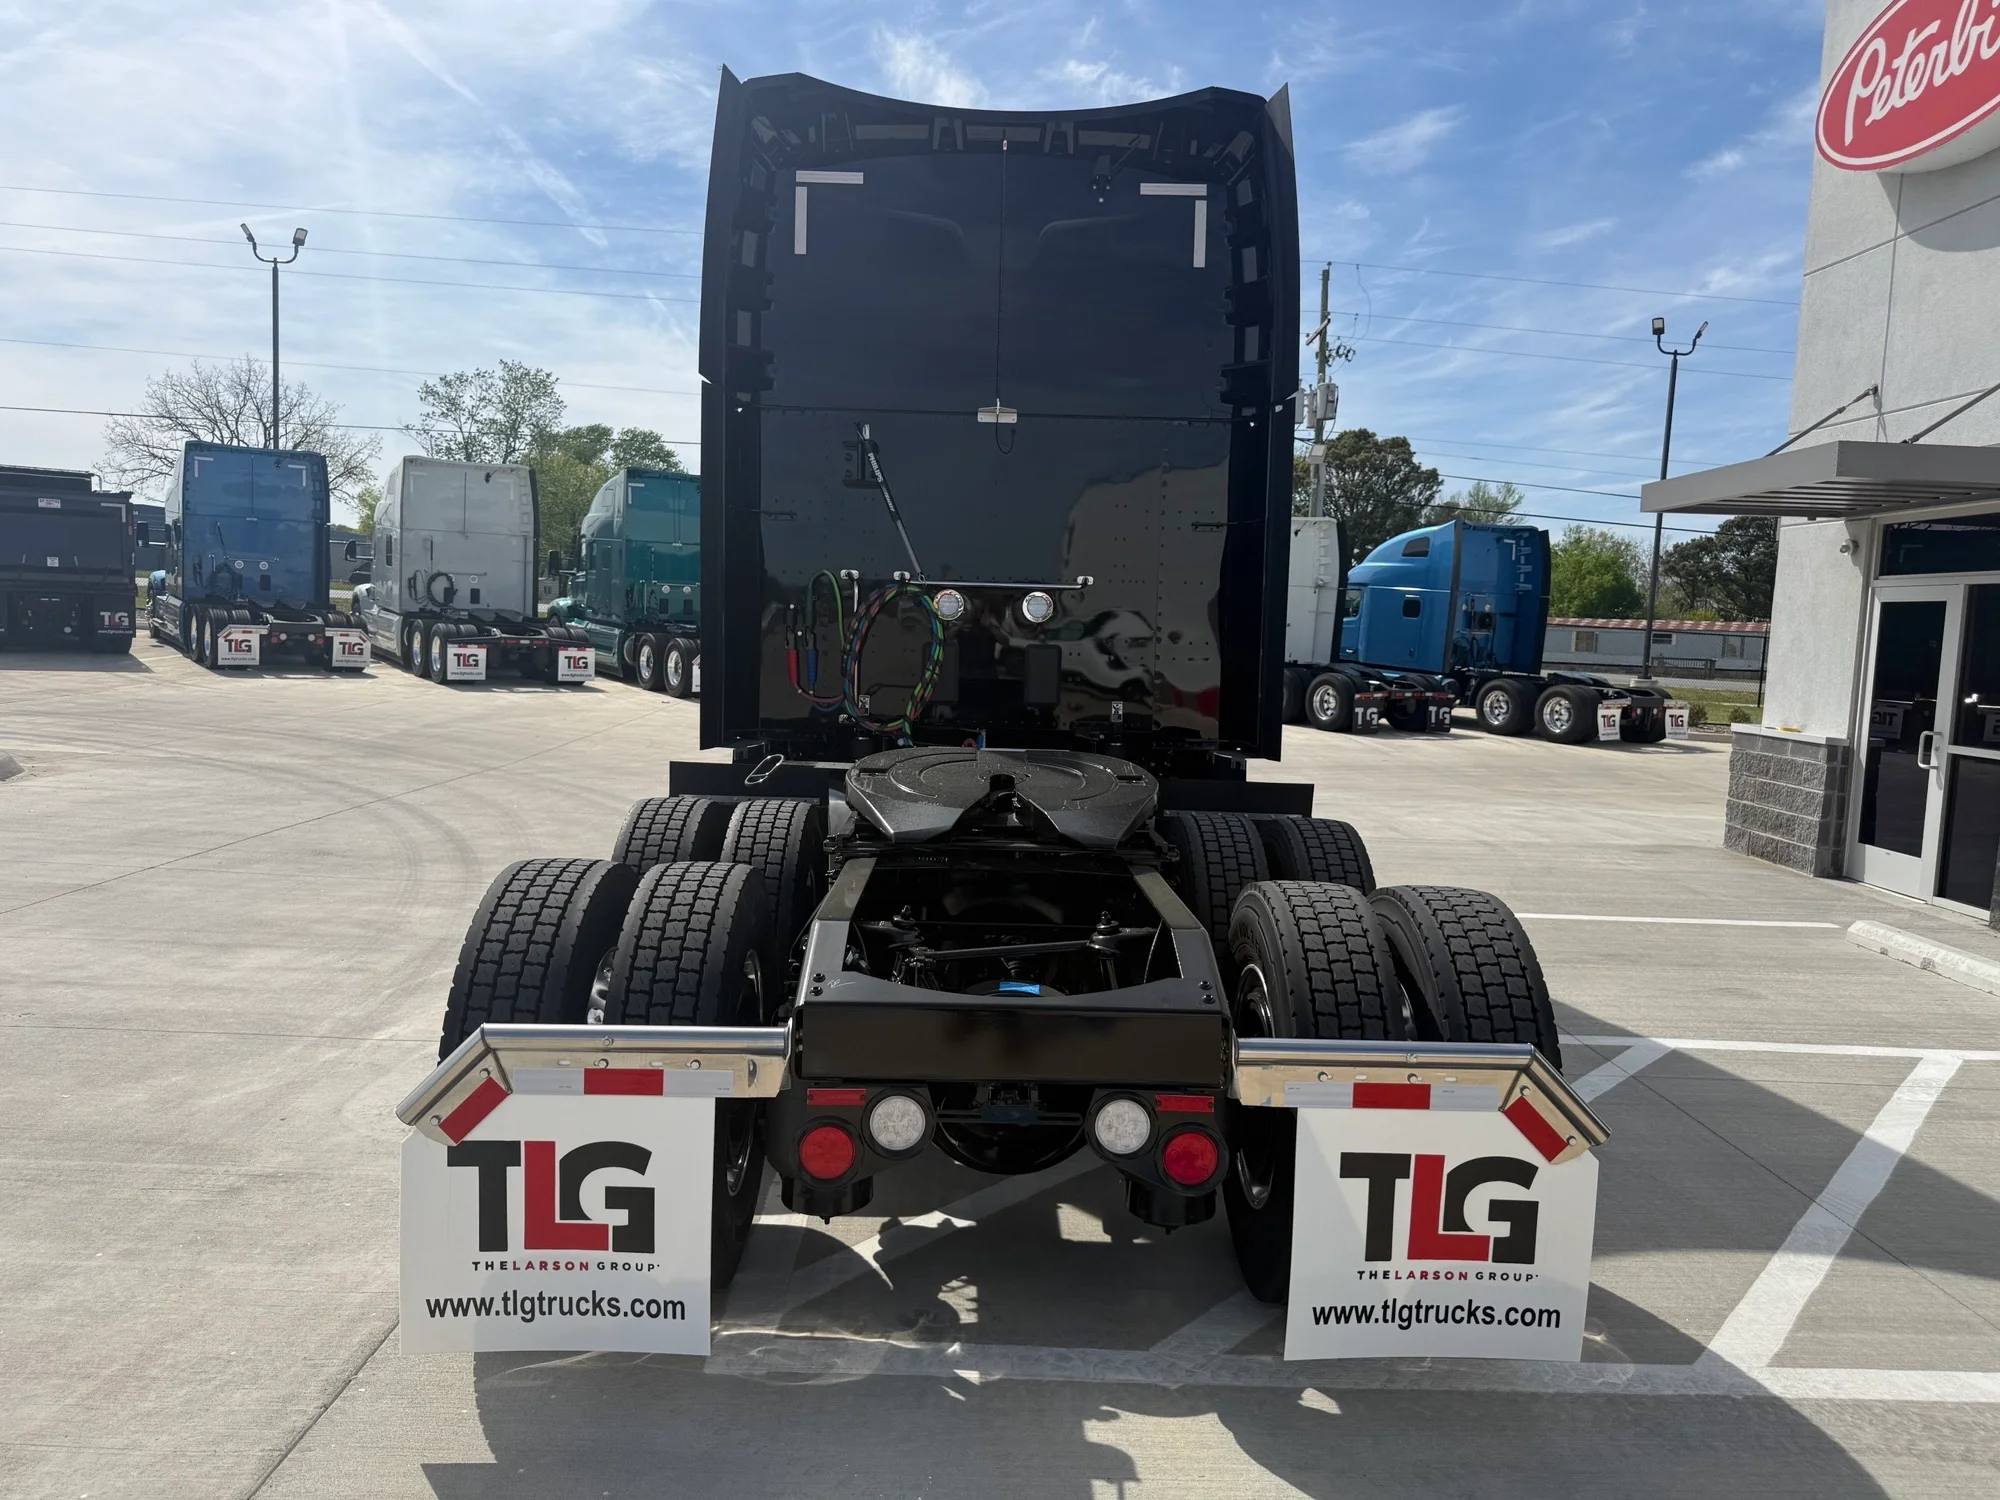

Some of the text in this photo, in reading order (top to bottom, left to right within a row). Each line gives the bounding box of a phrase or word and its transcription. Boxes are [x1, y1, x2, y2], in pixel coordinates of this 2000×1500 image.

[224, 638, 252, 653] TLG
[339, 641, 364, 656] TLG
[453, 653, 479, 667] TLG
[564, 656, 588, 669] TLG
[1601, 714, 1617, 729] TLG
[1669, 714, 1685, 728] TLG
[446, 1139, 656, 1255] TLG
[1339, 1151, 1541, 1265] TLG
[471, 1260, 656, 1273] THE LARSON GROUP
[1356, 1269, 1535, 1283] THE LARSON GROUP
[425, 1289, 687, 1323] www.tlgtrucks.com
[1311, 1297, 1562, 1331] www.tlgtrucks.com
